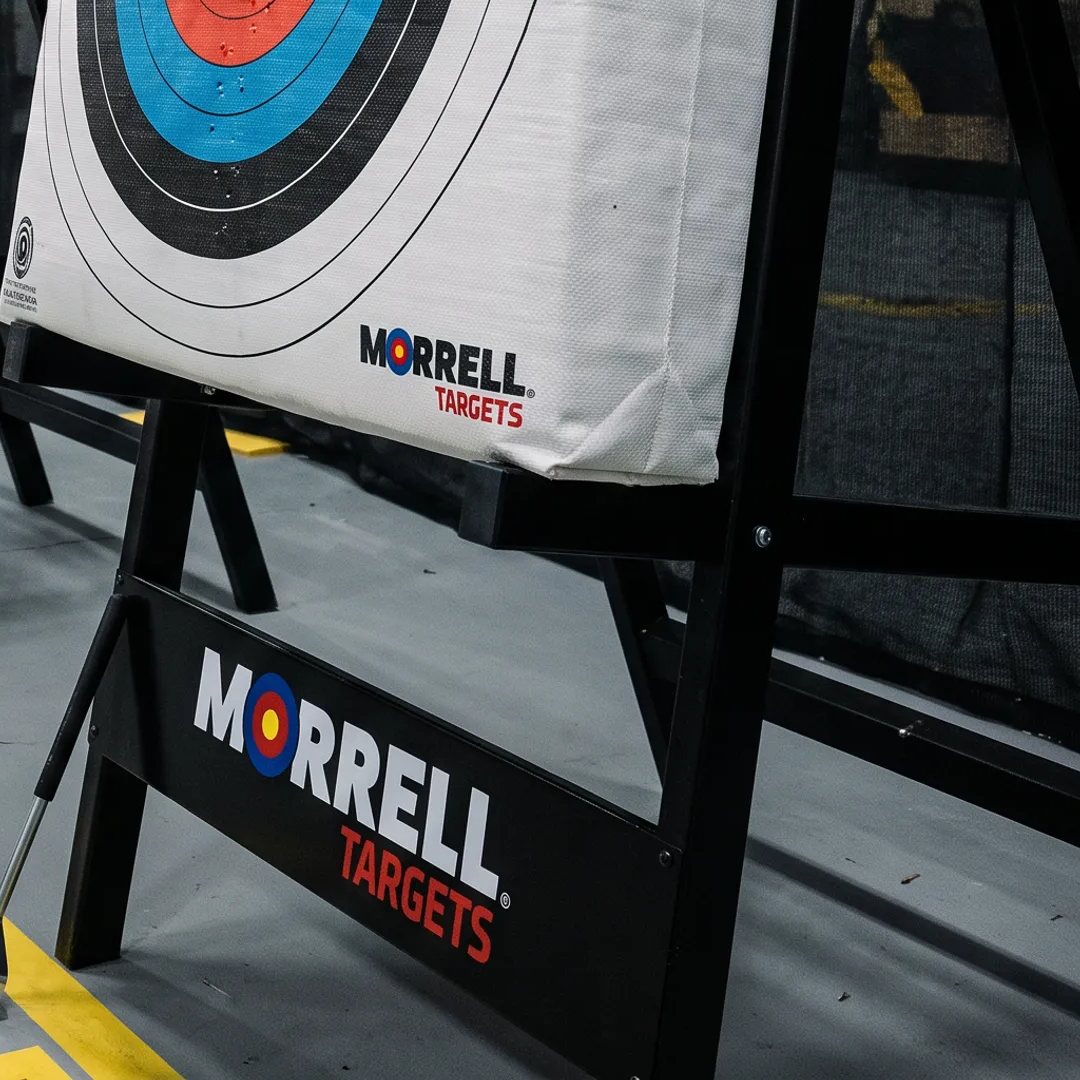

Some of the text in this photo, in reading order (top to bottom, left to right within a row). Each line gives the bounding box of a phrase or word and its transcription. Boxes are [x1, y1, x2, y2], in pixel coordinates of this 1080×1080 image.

[359, 323, 526, 397] MORRELL
[434, 385, 523, 428] TARGETS
[193, 646, 499, 901] MORRELL
[340, 824, 494, 964] TARGETS
